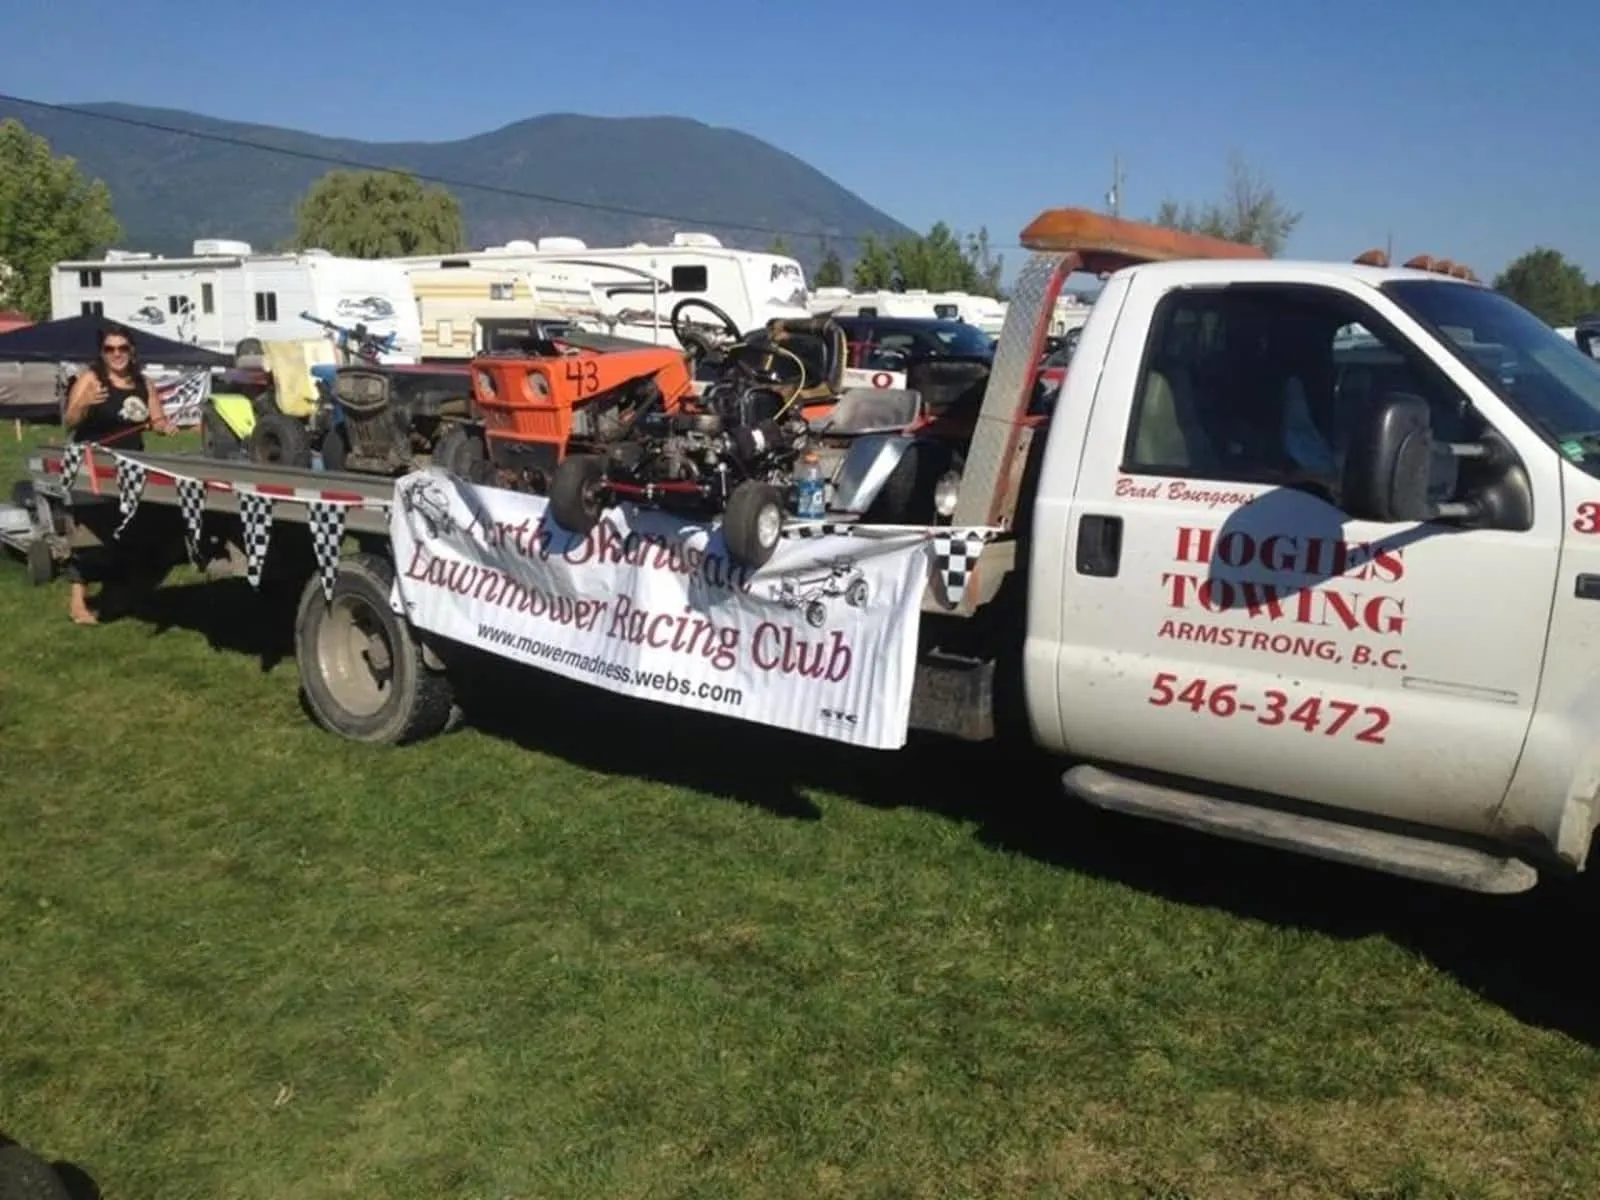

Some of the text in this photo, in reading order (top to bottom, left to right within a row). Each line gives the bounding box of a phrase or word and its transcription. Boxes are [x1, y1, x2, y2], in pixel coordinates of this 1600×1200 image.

[565, 360, 600, 396] 43
[1115, 478, 1162, 499] Brad
[1173, 526, 1405, 583] HOGIES
[405, 540, 852, 683] Lawnmower Racing Club
[1161, 572, 1407, 636] TOWING
[477, 622, 743, 706] www.mowermadness.webs.com
[1158, 620, 1408, 671] ARMSTRONG, B.C.
[1148, 672, 1391, 745] 546-3472
